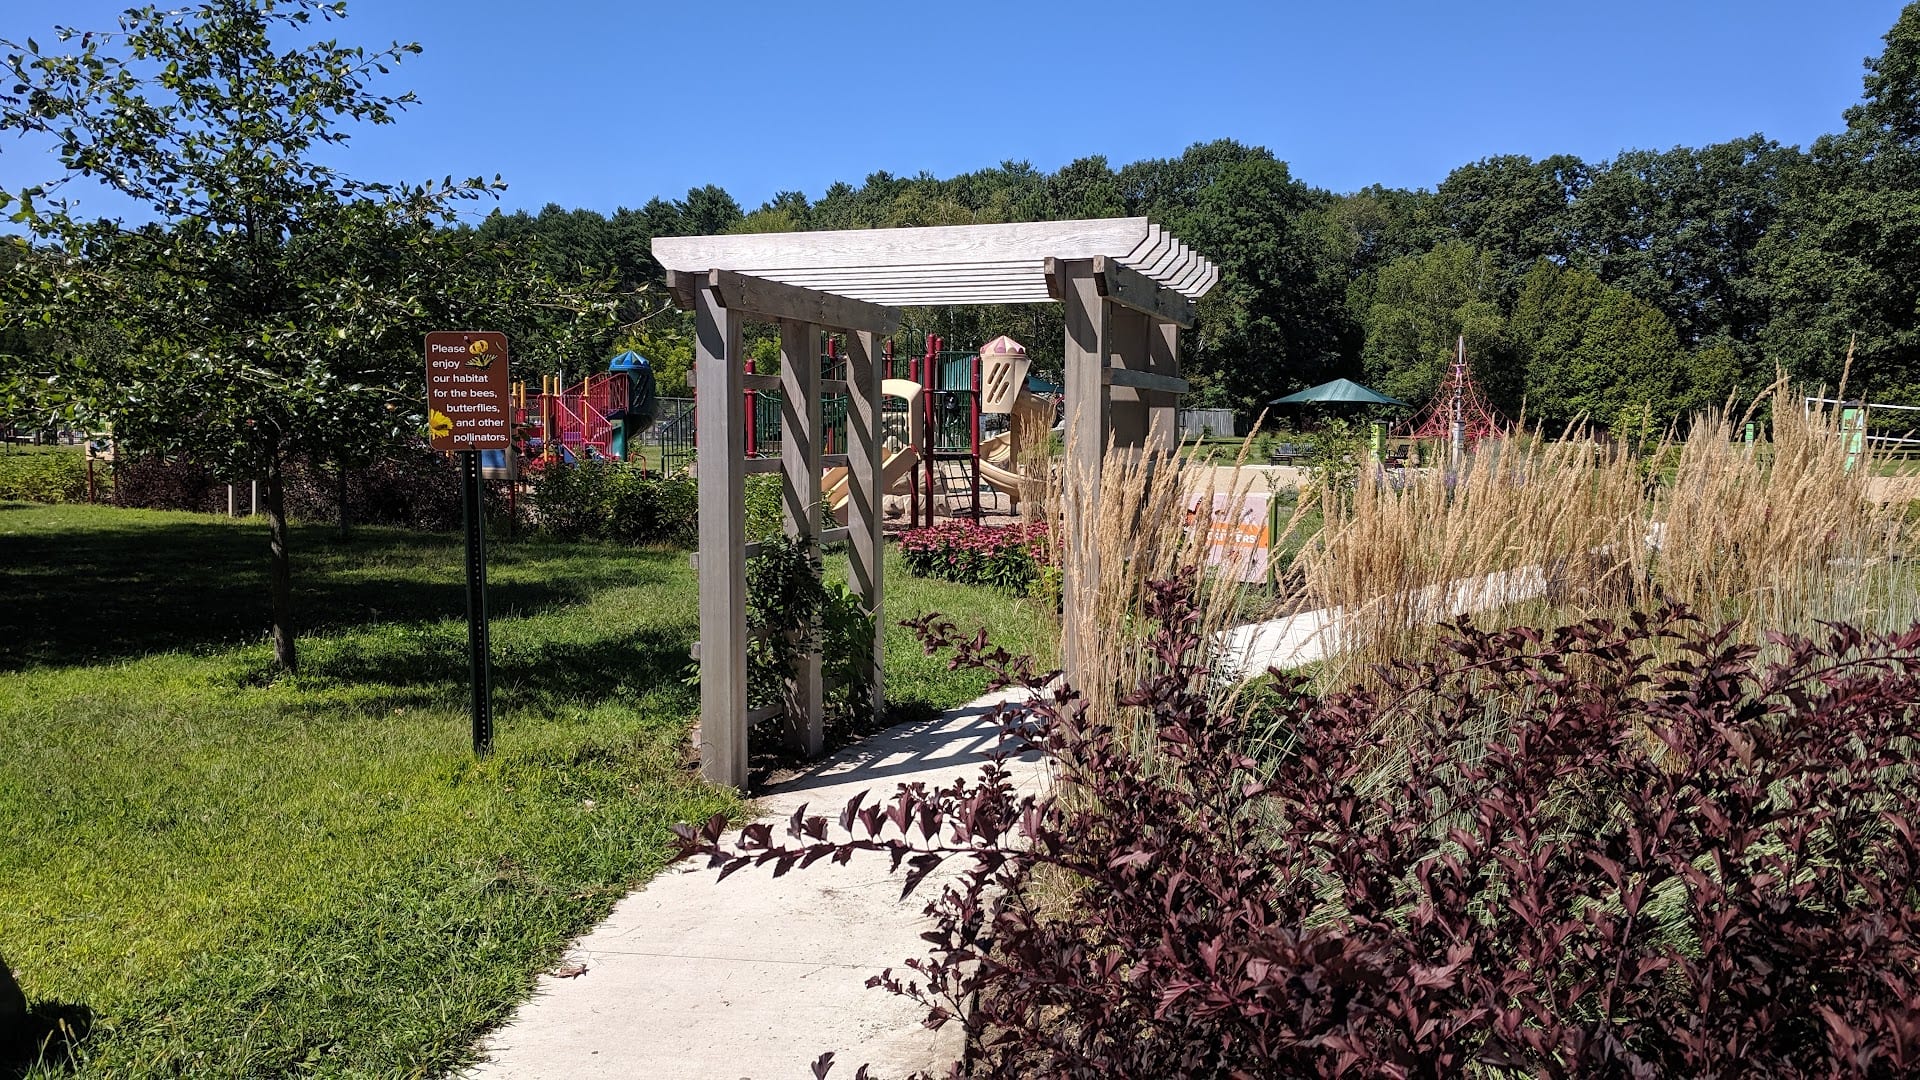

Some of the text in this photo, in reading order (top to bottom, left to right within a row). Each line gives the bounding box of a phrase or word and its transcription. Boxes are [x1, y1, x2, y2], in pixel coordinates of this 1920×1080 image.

[432, 344, 465, 353] Please
[432, 360, 460, 369] enjoy
[453, 374, 488, 383] habitat
[434, 389, 497, 398] for the bees,
[447, 404, 500, 413] butterflies,
[456, 418, 504, 427] and other
[454, 433, 508, 443] pollinators.
